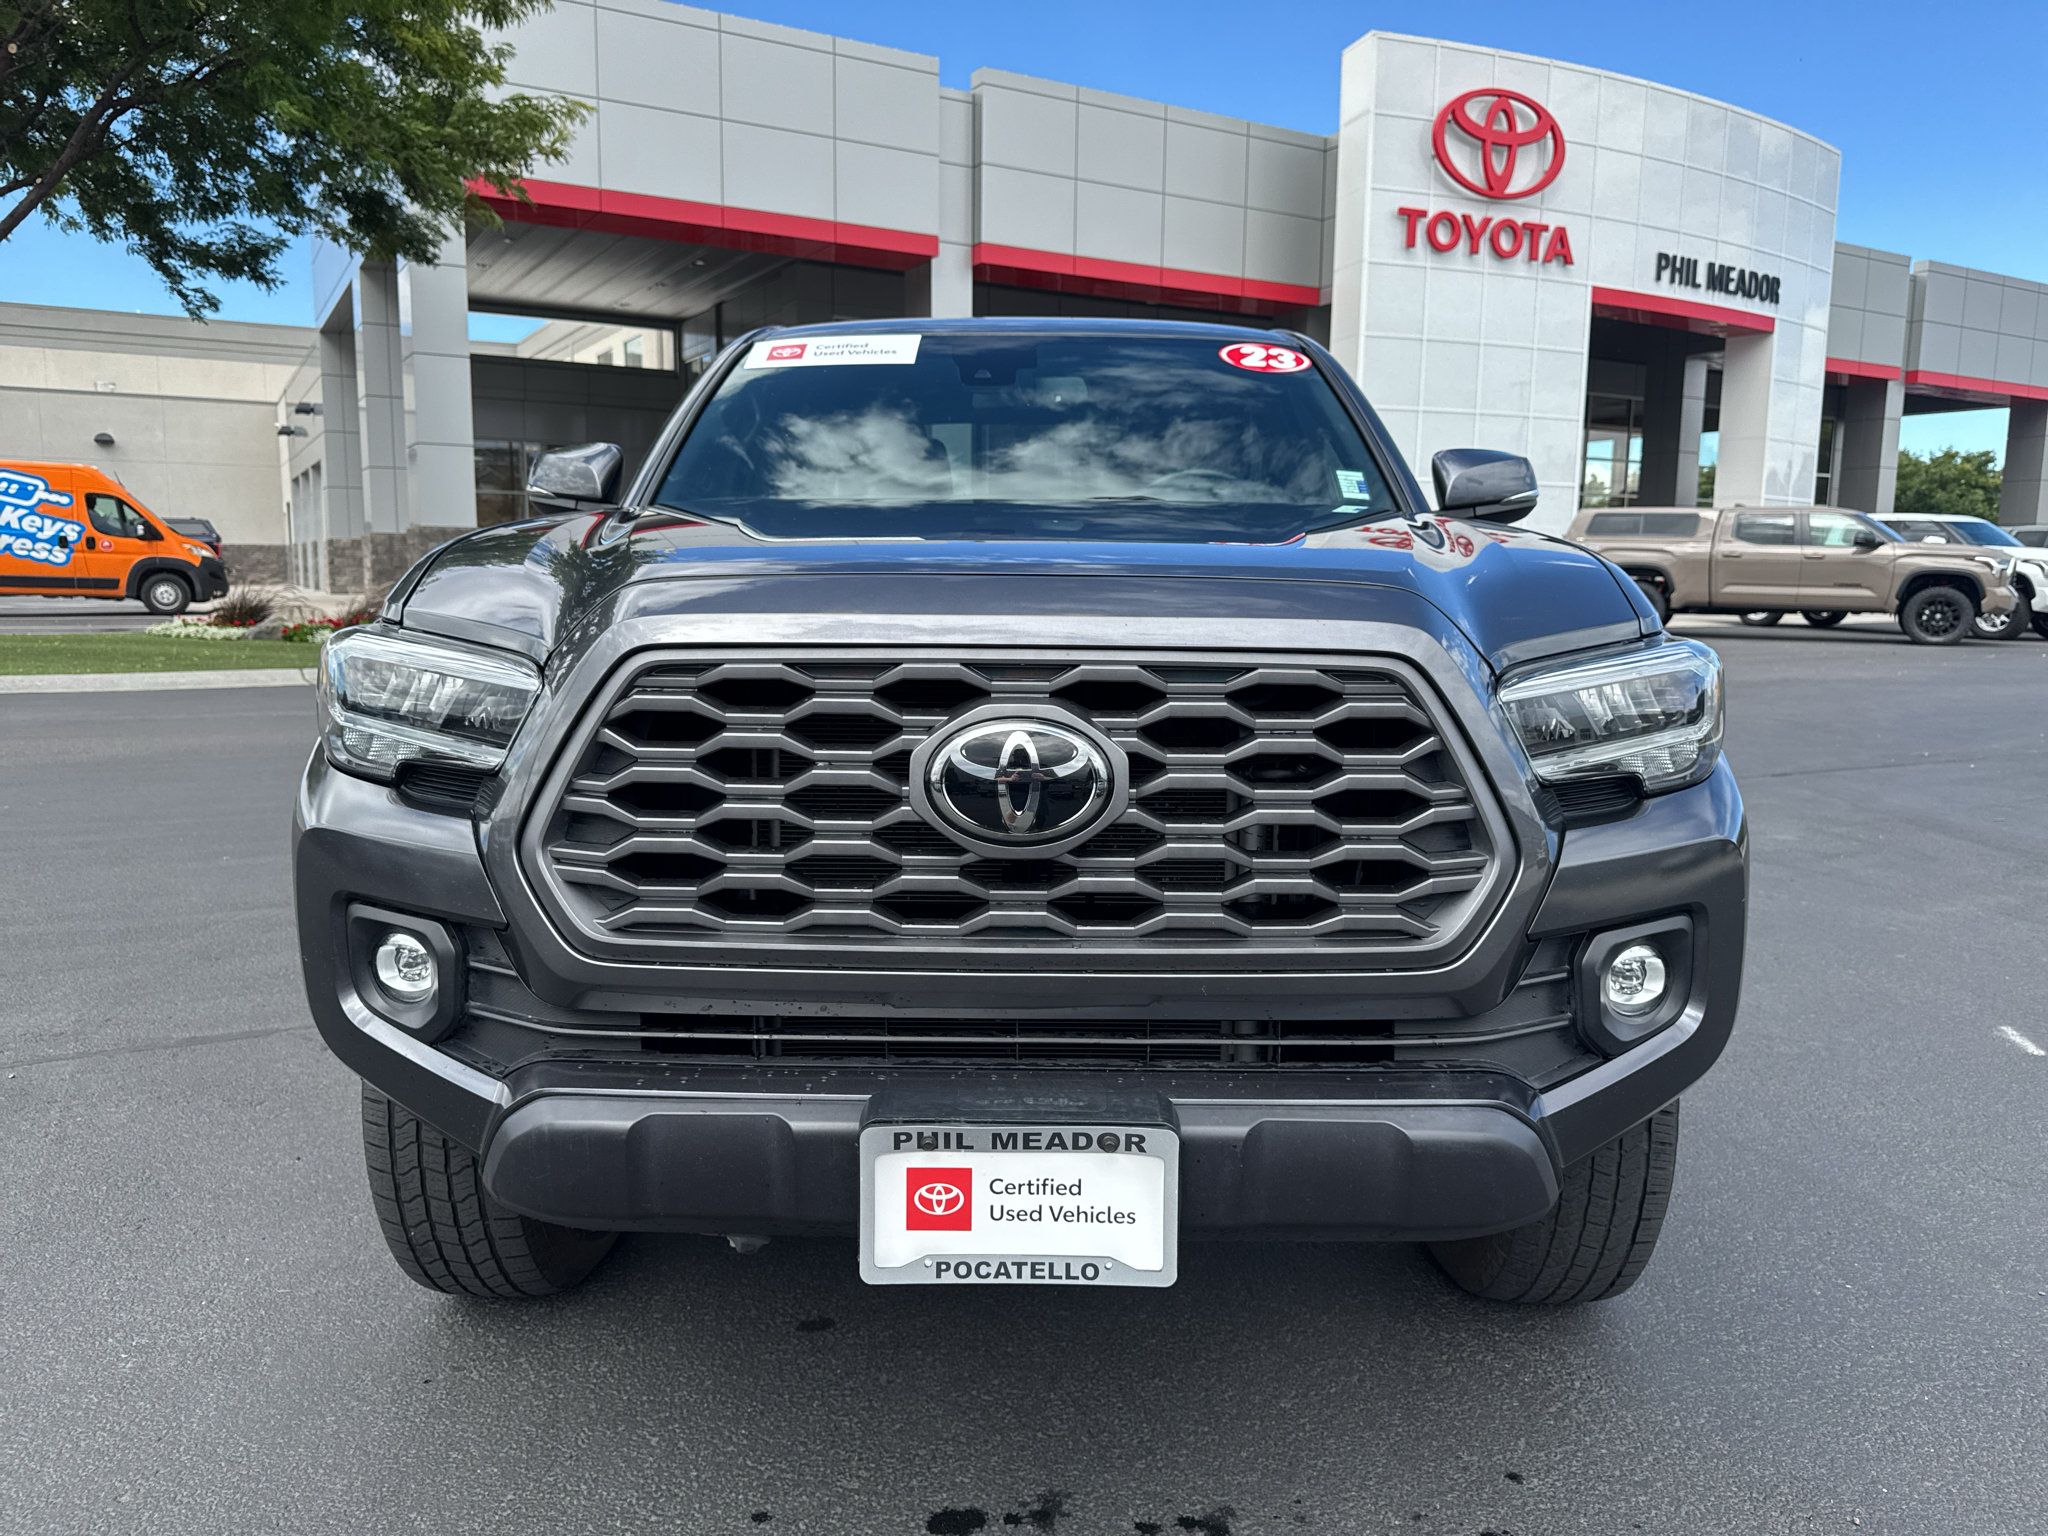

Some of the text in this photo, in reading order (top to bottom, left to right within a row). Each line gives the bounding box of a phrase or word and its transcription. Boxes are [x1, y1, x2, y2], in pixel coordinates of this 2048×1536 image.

[1397, 207, 1574, 266] TOYOTA
[1655, 252, 1781, 305] PHIL MEADOR
[1239, 346, 1298, 369] 23
[0, 505, 82, 542] Keys
[893, 1131, 1147, 1153] PHIL MEADOR
[989, 1178, 1082, 1196] Certified
[989, 1204, 1137, 1225] Used Vehicles
[935, 1260, 1100, 1281] POCATELLO
